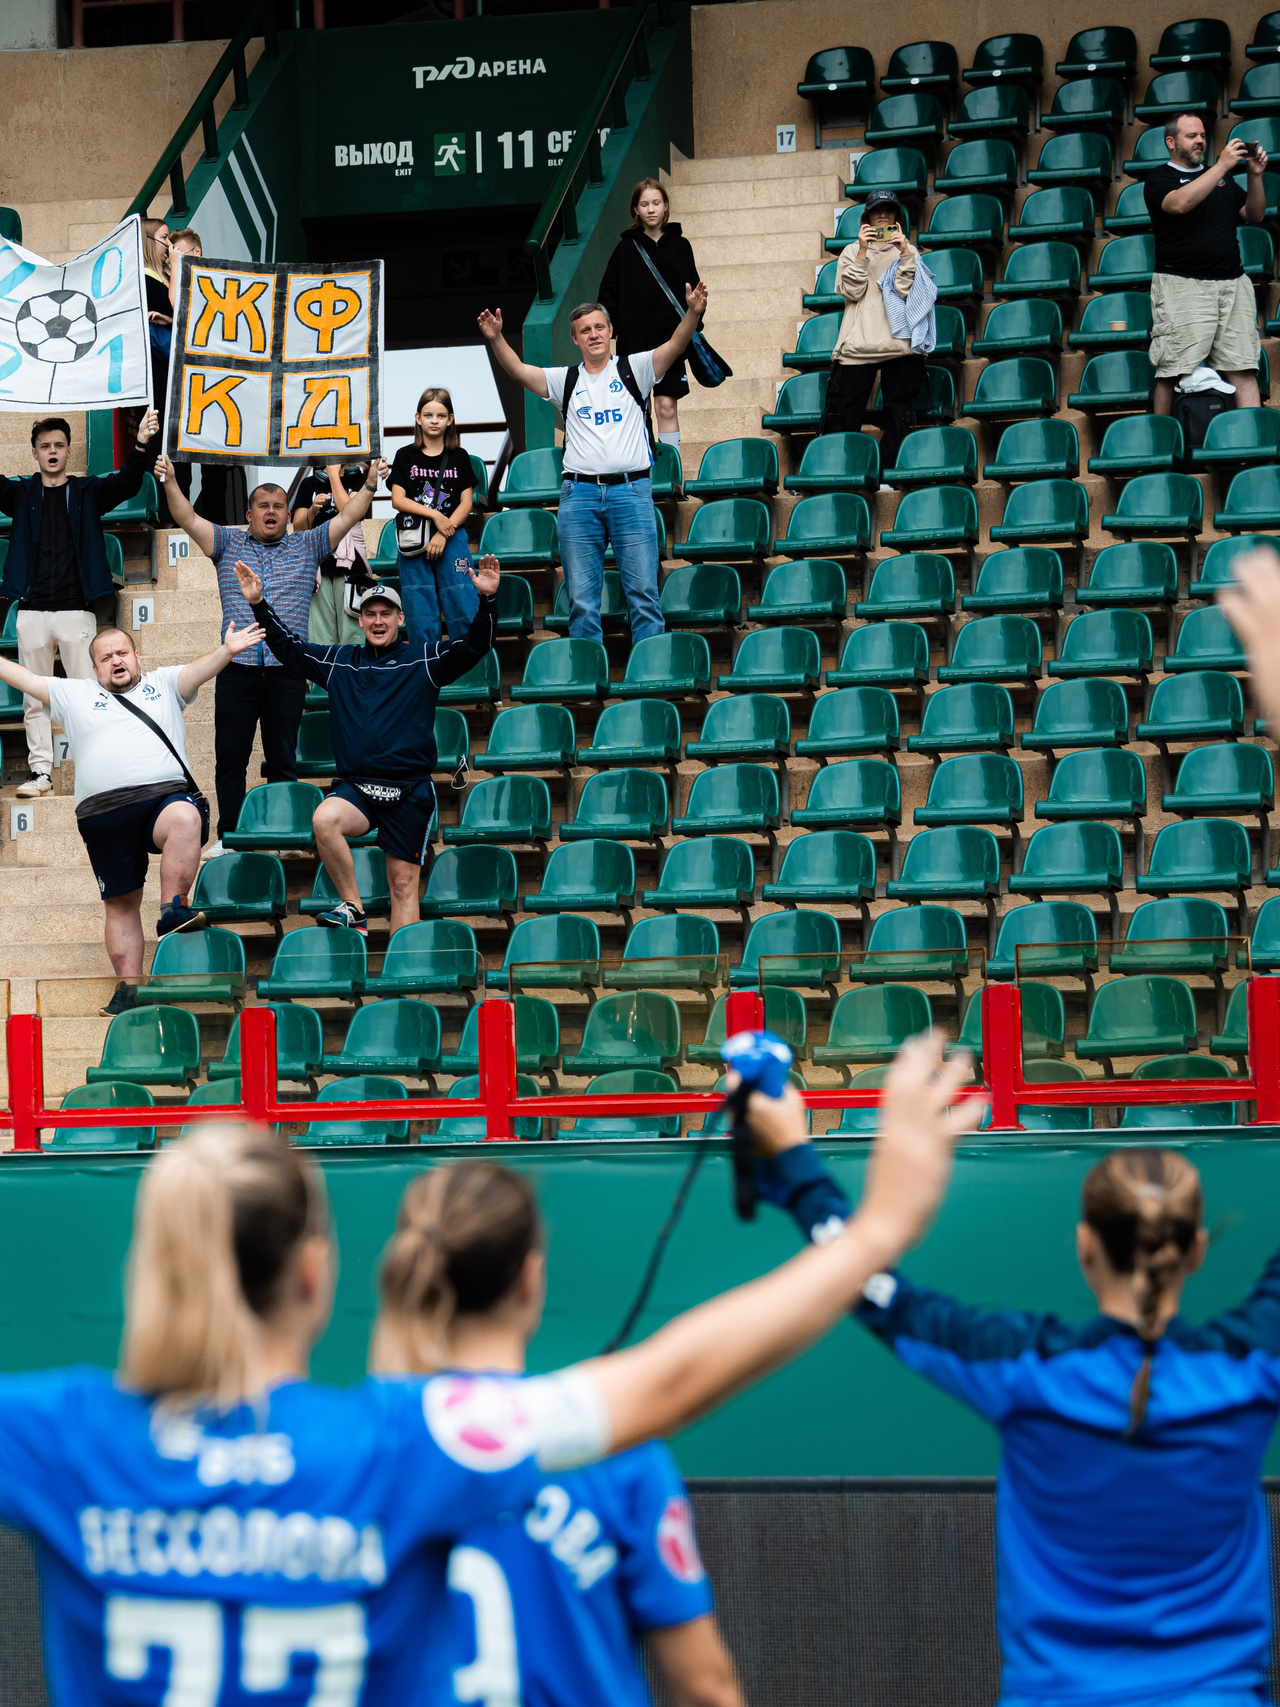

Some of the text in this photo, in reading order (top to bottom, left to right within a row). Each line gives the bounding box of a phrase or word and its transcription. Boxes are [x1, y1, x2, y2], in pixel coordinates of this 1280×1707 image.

[478, 58, 547, 78] АРЕНА
[778, 131, 795, 146] 17
[335, 141, 414, 167] ВЫХОД
[498, 130, 534, 169] 11
[395, 168, 412, 176] EXIT
[595, 408, 622, 425] ВТБ
[170, 542, 188, 558] 10
[138, 606, 149, 623] 9
[60, 742, 69, 760] 7
[17, 813, 27, 831] 6
